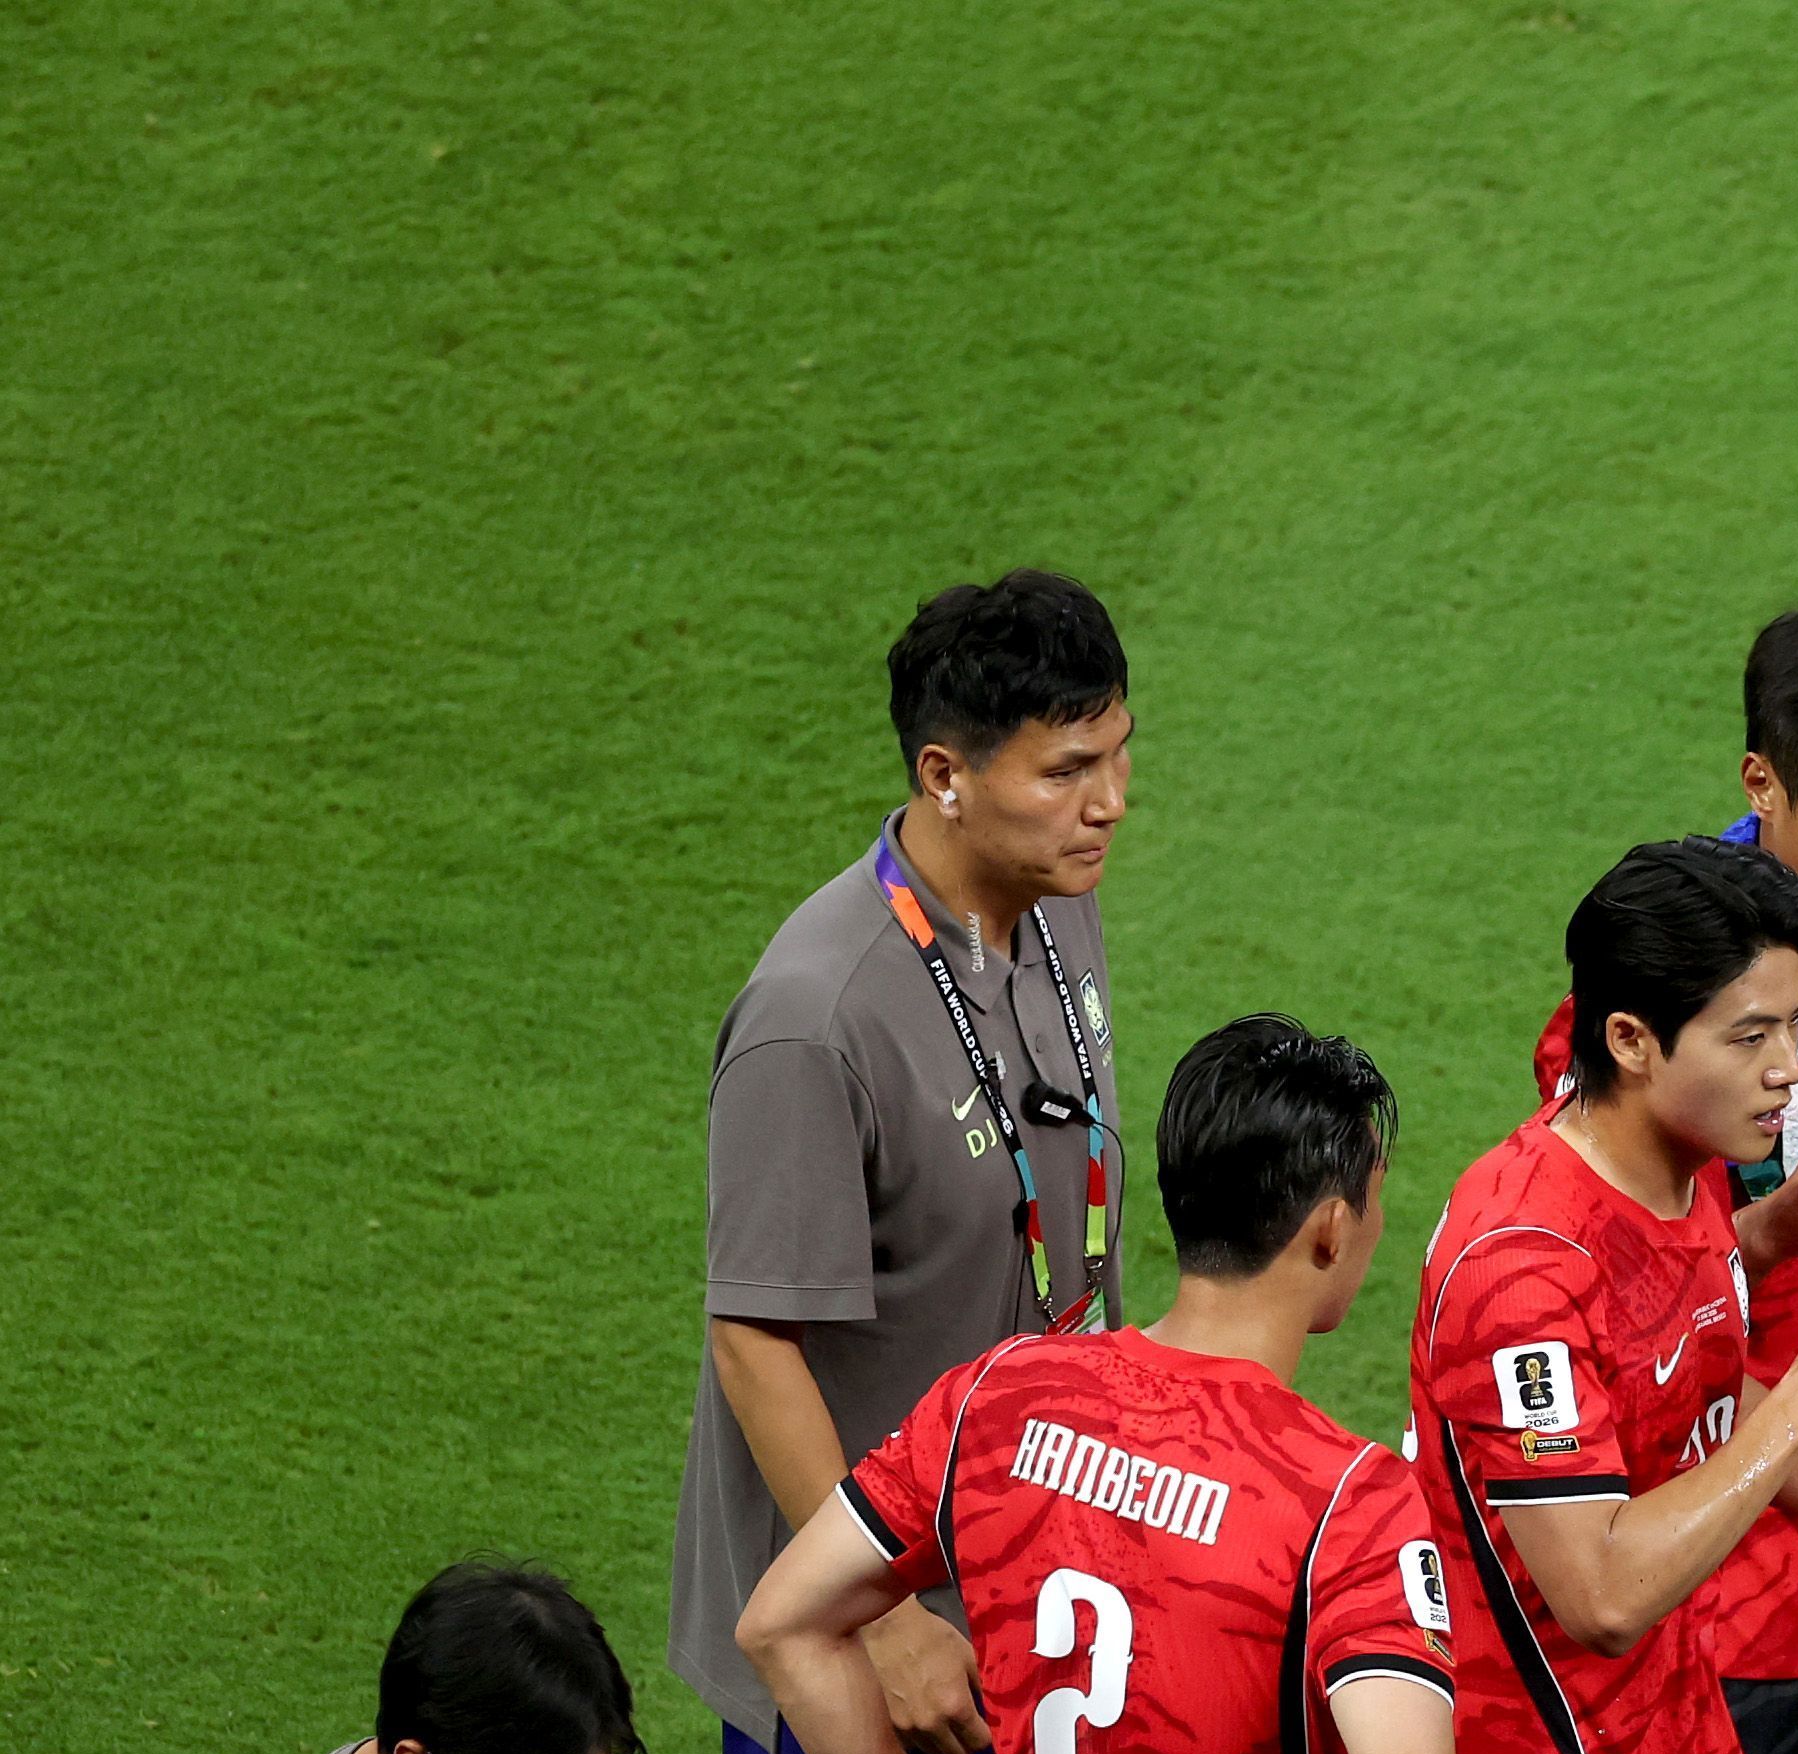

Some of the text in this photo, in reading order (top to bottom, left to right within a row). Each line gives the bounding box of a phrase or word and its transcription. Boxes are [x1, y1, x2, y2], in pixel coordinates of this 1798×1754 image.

[1049, 950, 1064, 984] CUP
[930, 959, 953, 996] FIFA
[947, 991, 976, 1050] WORLD
[1059, 984, 1082, 1045] WORLD
[1077, 1043, 1092, 1080] FIFA
[965, 1118, 998, 1159] DJ
[1529, 1397, 1548, 1407] FIFA
[1525, 1416, 1560, 1428] 2026
[1536, 1439, 1573, 1448] DEBUT
[1009, 1418, 1230, 1546] HANBEOM
[1430, 1613, 1448, 1624] 202
